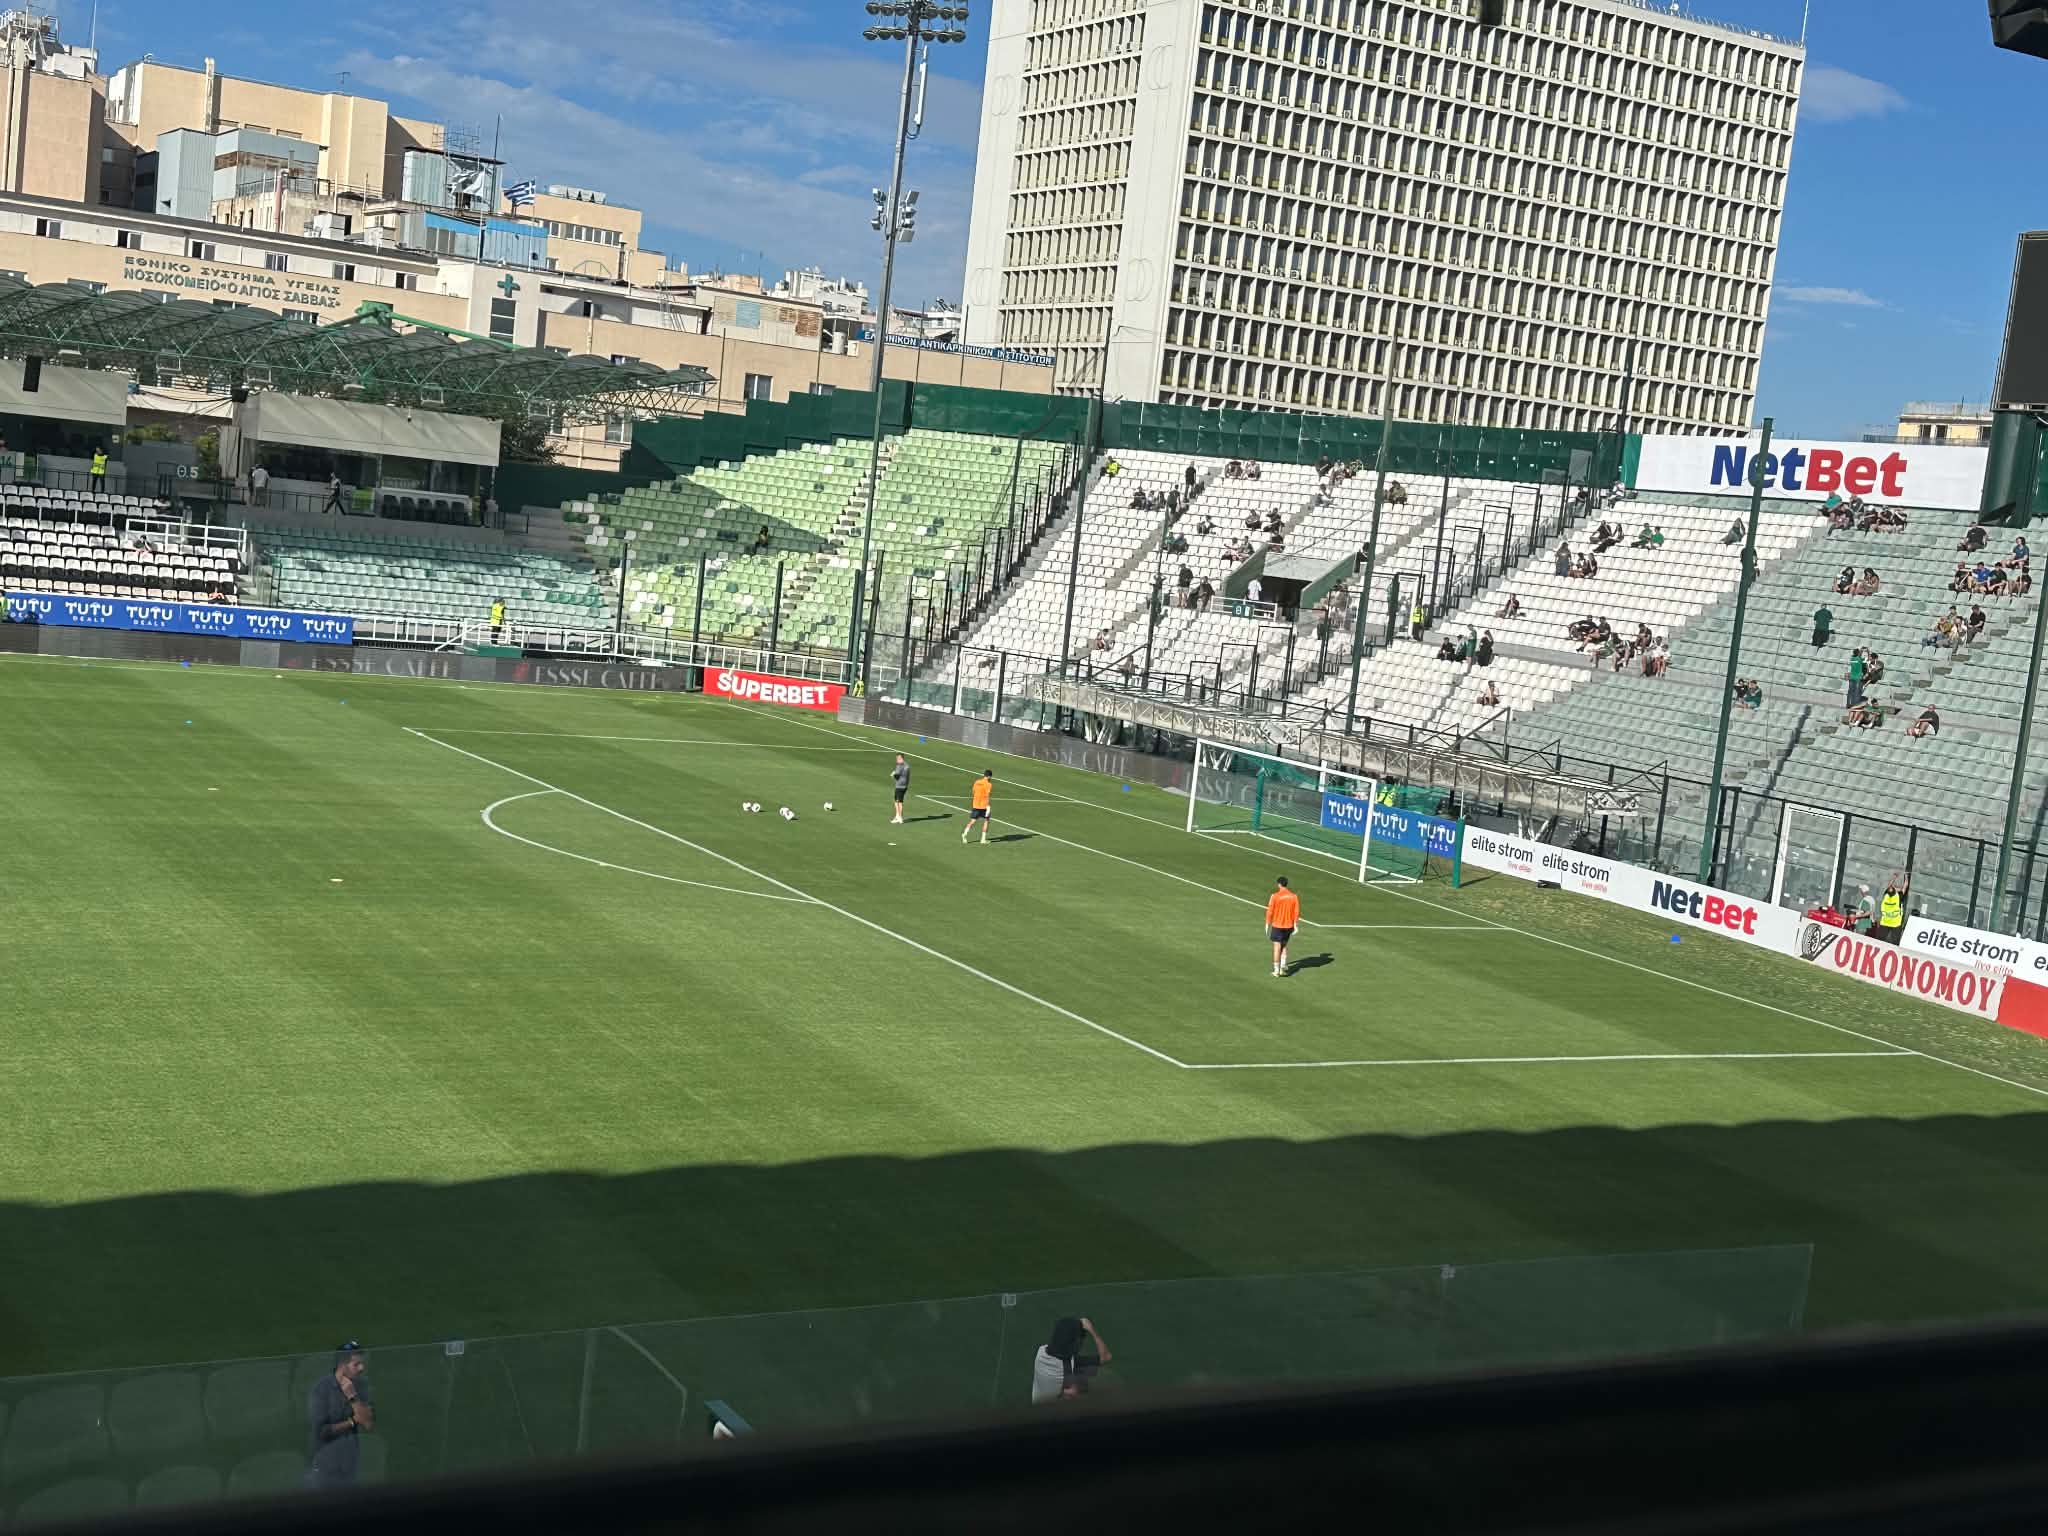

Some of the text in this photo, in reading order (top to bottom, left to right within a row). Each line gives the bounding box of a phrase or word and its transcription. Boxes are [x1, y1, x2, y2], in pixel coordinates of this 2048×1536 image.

[124, 256, 341, 294] ΕΘΝΙΚΟ ΣΥΣΤΗΜΑ ΥΓΕΙΑΣ
[1710, 445, 1908, 497] NetBet
[65, 602, 113, 617] TUTU
[126, 605, 173, 621] TUTU
[188, 610, 234, 625] TUTU
[246, 614, 291, 629] TUTU
[302, 619, 347, 634] TUTU
[716, 671, 828, 705] SUPERBET
[1328, 800, 1363, 821] TUTU
[1417, 821, 1456, 844] TUTU
[1471, 835, 1533, 863] elite strom
[1542, 852, 1610, 883] elite strom
[1651, 879, 1758, 935] NetBet
[1916, 928, 1958, 950] elite
[1960, 938, 2019, 964] strom
[1834, 935, 1996, 1012] OIKONOMOY
